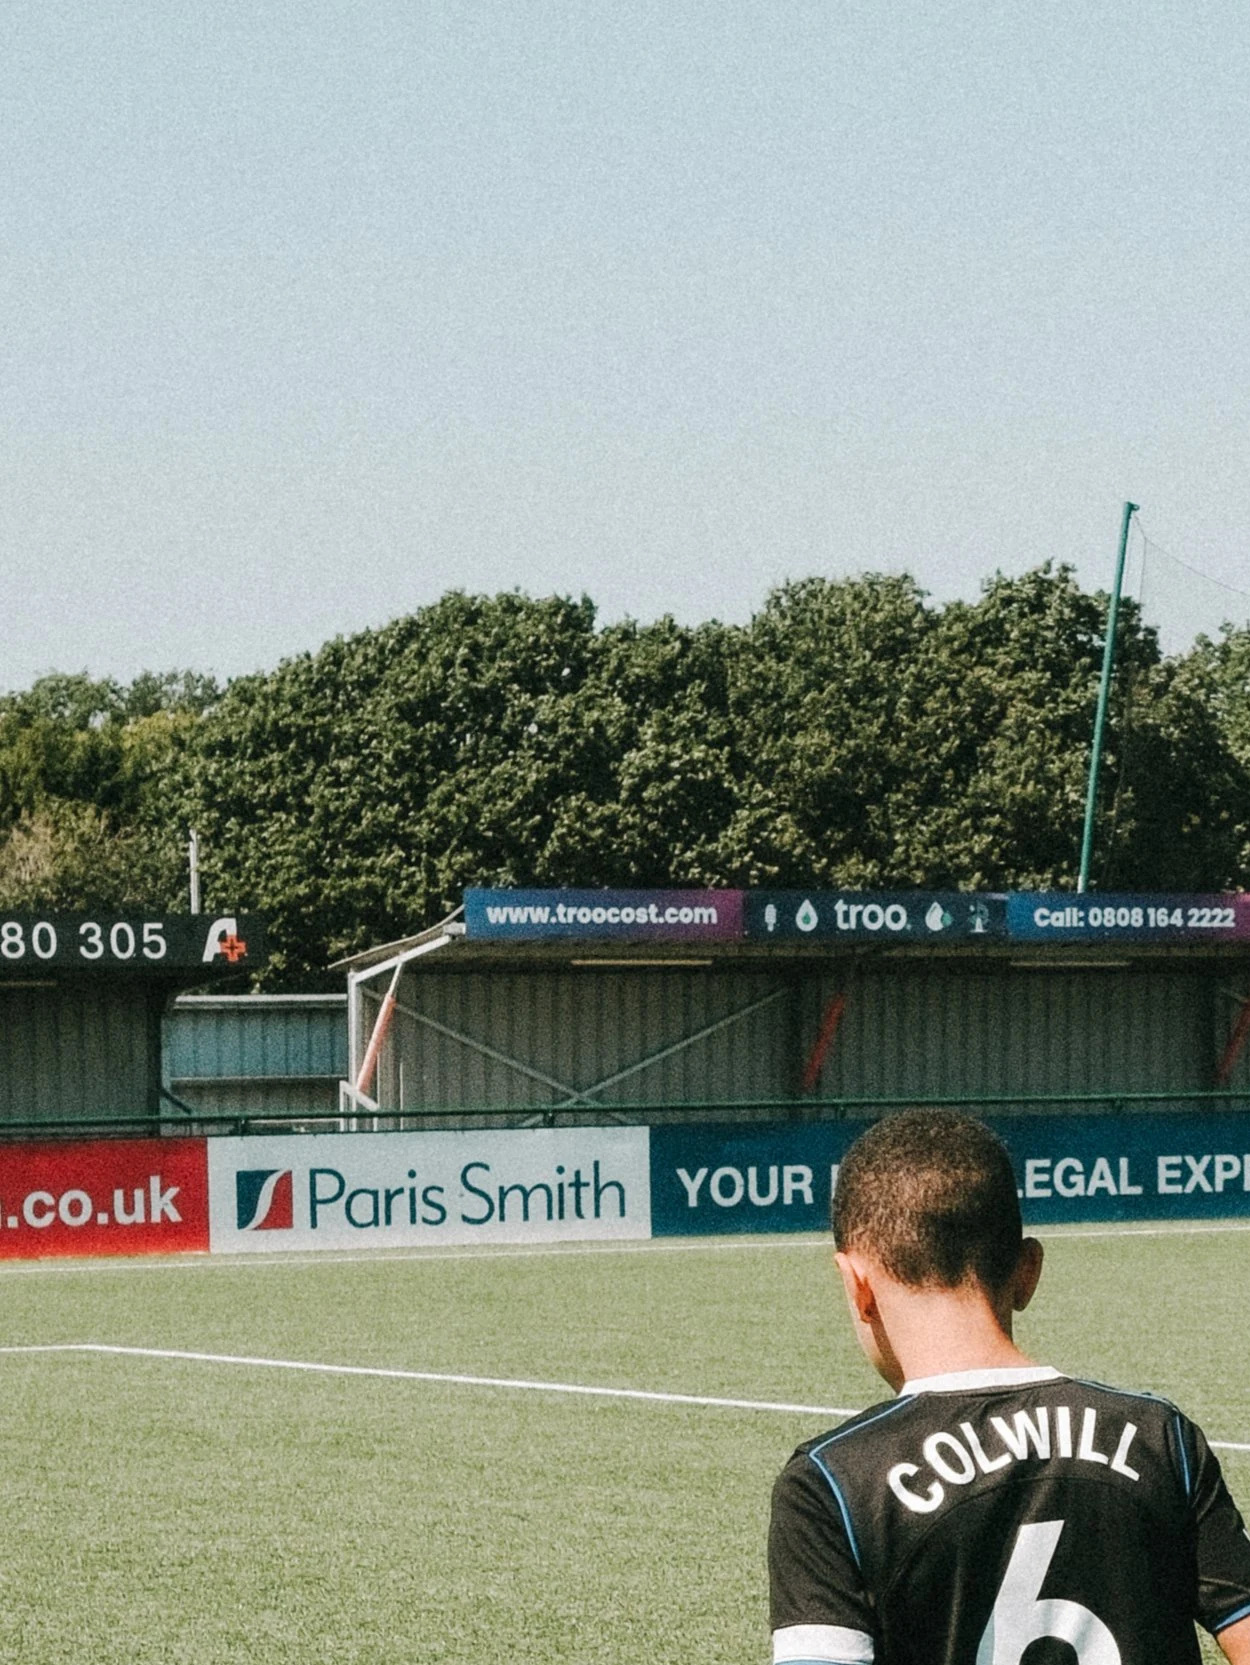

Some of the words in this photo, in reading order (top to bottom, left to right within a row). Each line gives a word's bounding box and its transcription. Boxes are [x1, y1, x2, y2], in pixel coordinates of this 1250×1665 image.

[486, 903, 718, 925] www.troocost.com
[1034, 908, 1085, 928] Call:
[1088, 908, 1144, 928] 0808
[1147, 908, 1183, 928] 164
[1187, 908, 1236, 928] 2222
[79, 921, 167, 960] 305
[0, 1175, 183, 1229] .co.uk
[309, 1168, 447, 1229] Paris
[460, 1160, 626, 1226] Smith
[676, 1164, 814, 1208] YOUR
[1018, 1157, 1143, 1199] EGAL
[886, 1406, 1140, 1515] COLWILL
